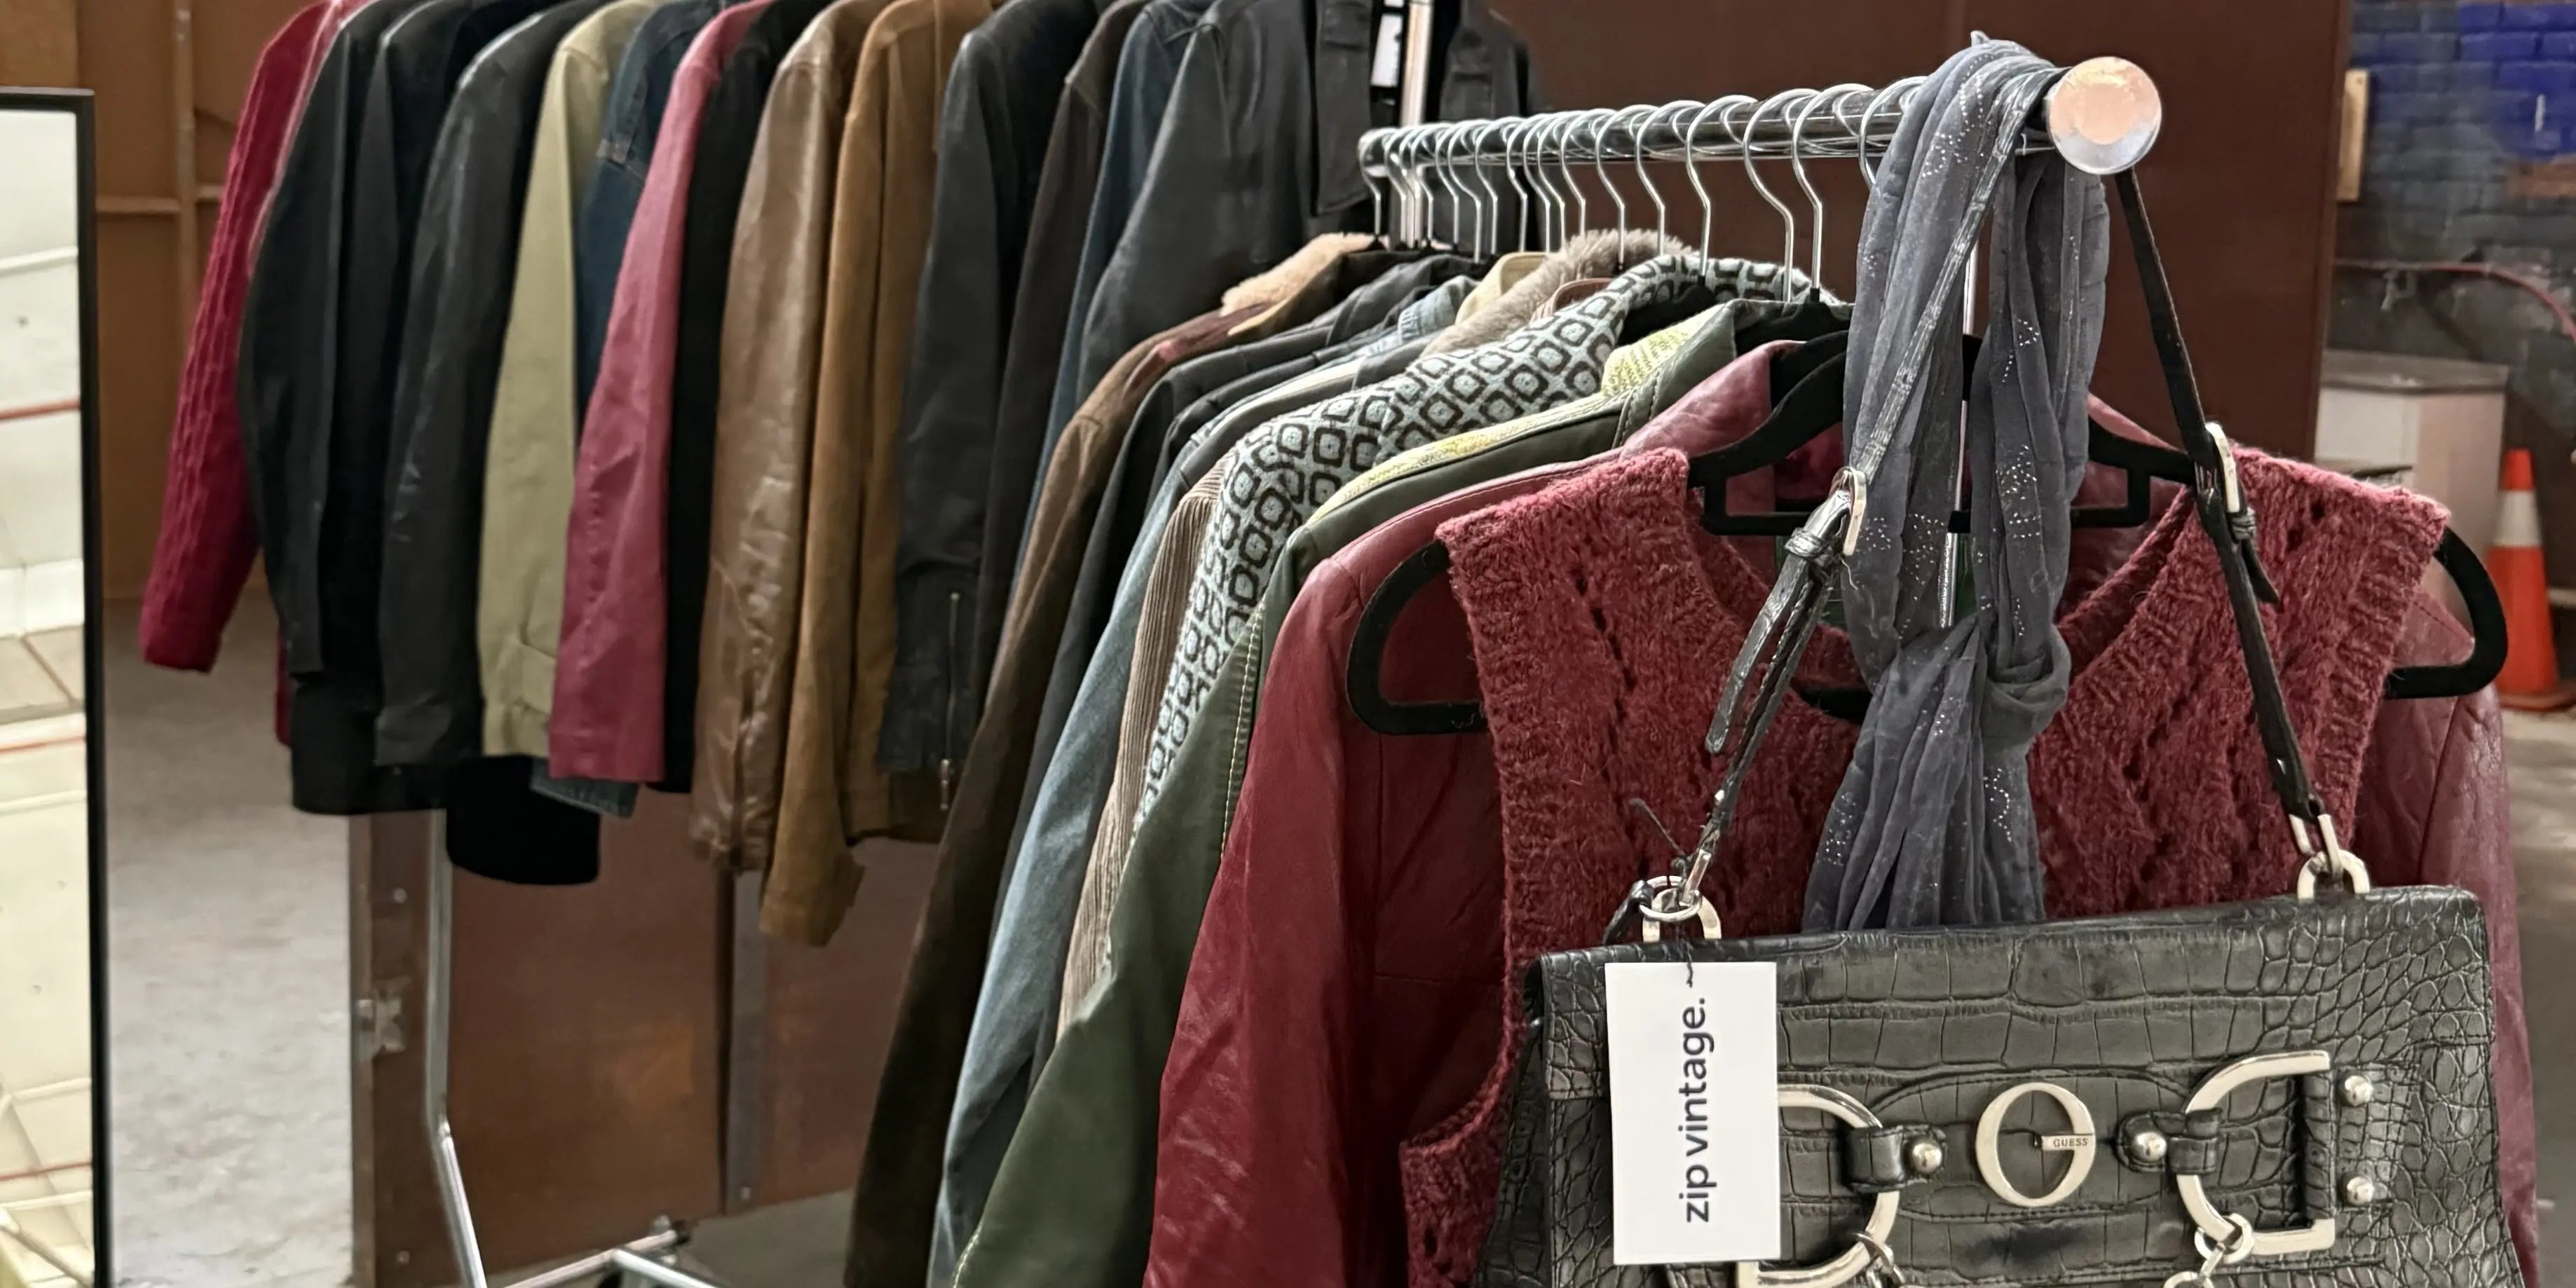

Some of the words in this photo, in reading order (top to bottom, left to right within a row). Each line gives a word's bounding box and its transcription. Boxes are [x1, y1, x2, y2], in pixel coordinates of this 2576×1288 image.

[1678, 998, 1715, 1157] vintage.
[2052, 1138, 2088, 1147] GUESS
[1679, 1165, 1717, 1223] zip
